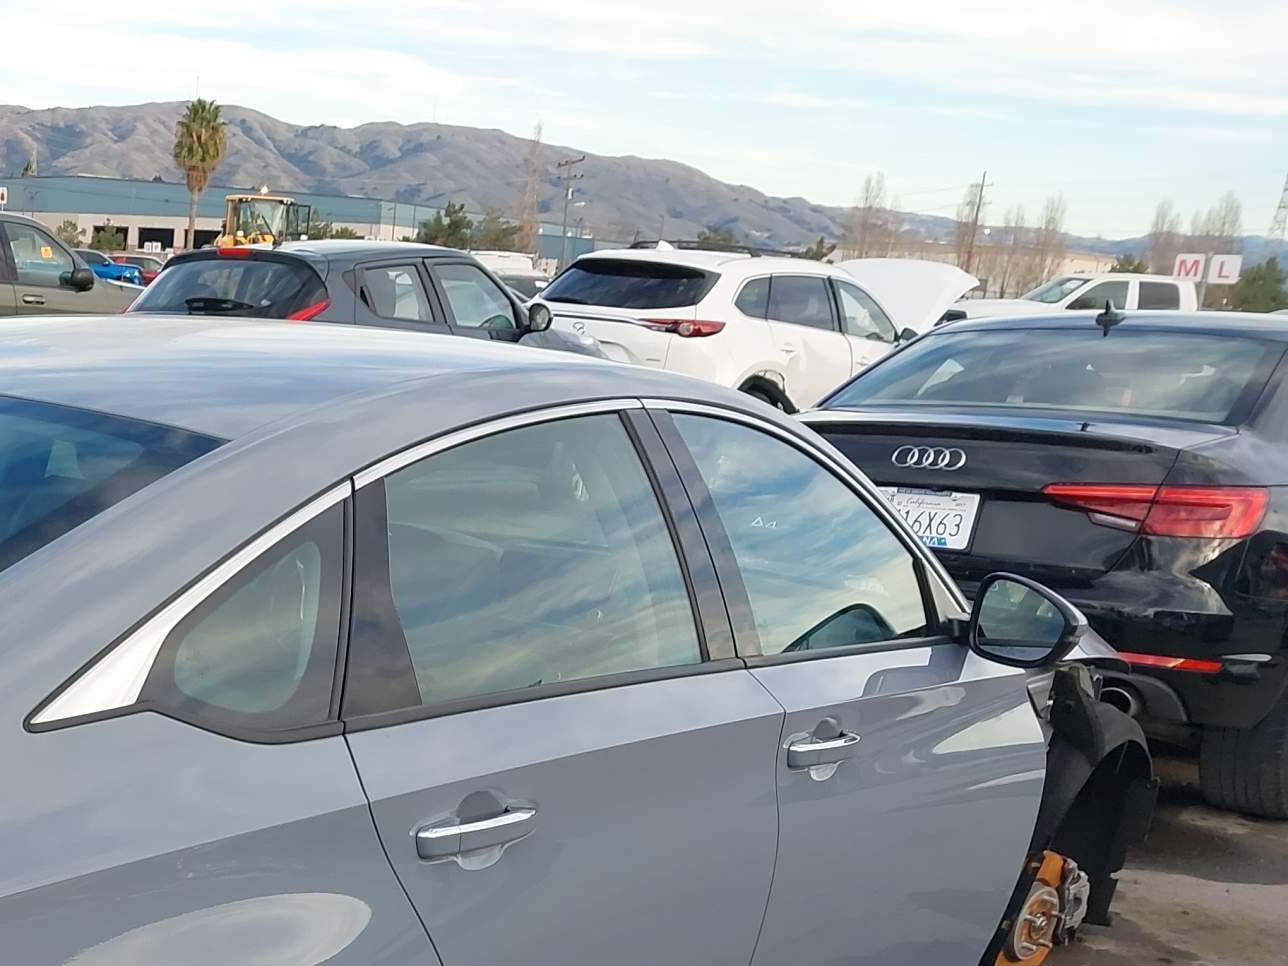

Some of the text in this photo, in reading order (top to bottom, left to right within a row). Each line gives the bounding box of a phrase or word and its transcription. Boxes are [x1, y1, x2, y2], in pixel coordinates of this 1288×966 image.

[1177, 259, 1200, 277] M
[1217, 261, 1230, 279] L
[898, 508, 964, 537] 16X63
